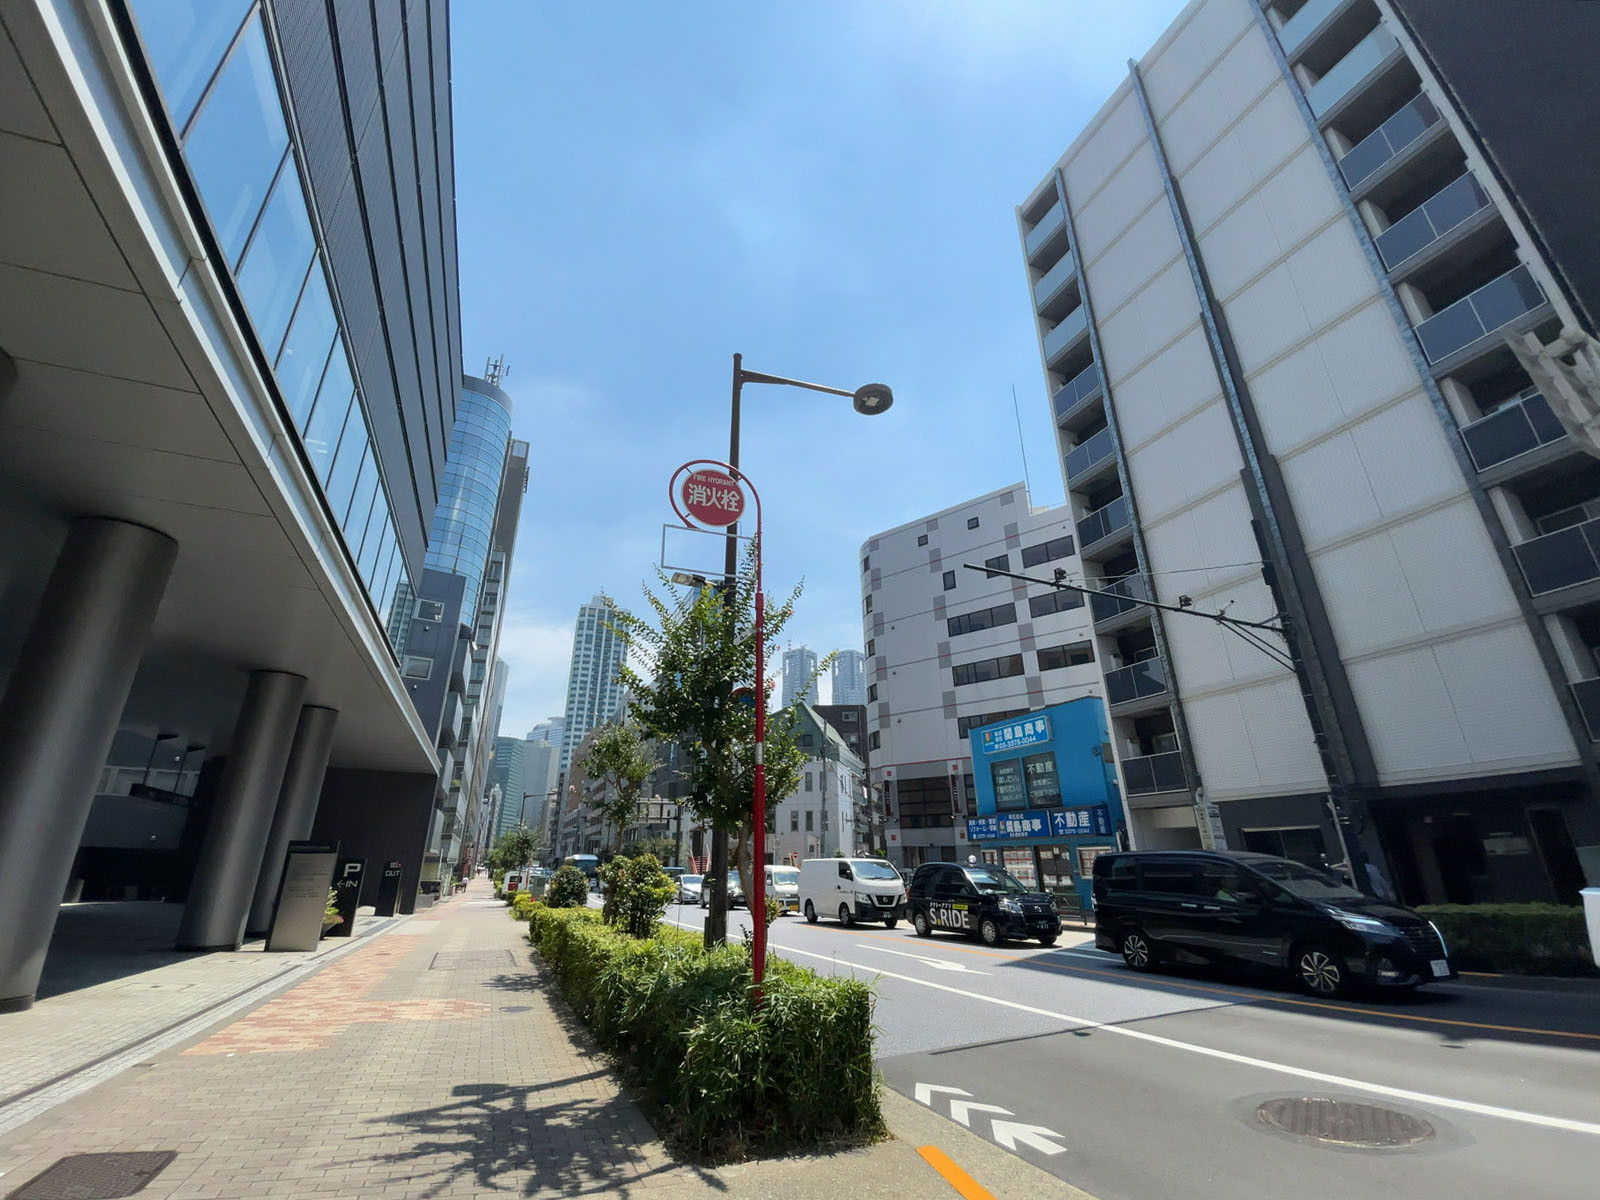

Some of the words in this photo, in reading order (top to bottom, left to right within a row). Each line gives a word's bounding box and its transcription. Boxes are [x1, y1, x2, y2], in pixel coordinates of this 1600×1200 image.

[688, 483, 740, 512] 消火栓
[1026, 761, 1054, 774] 不動産
[1053, 811, 1091, 828] 不動産
[343, 863, 361, 877] P
